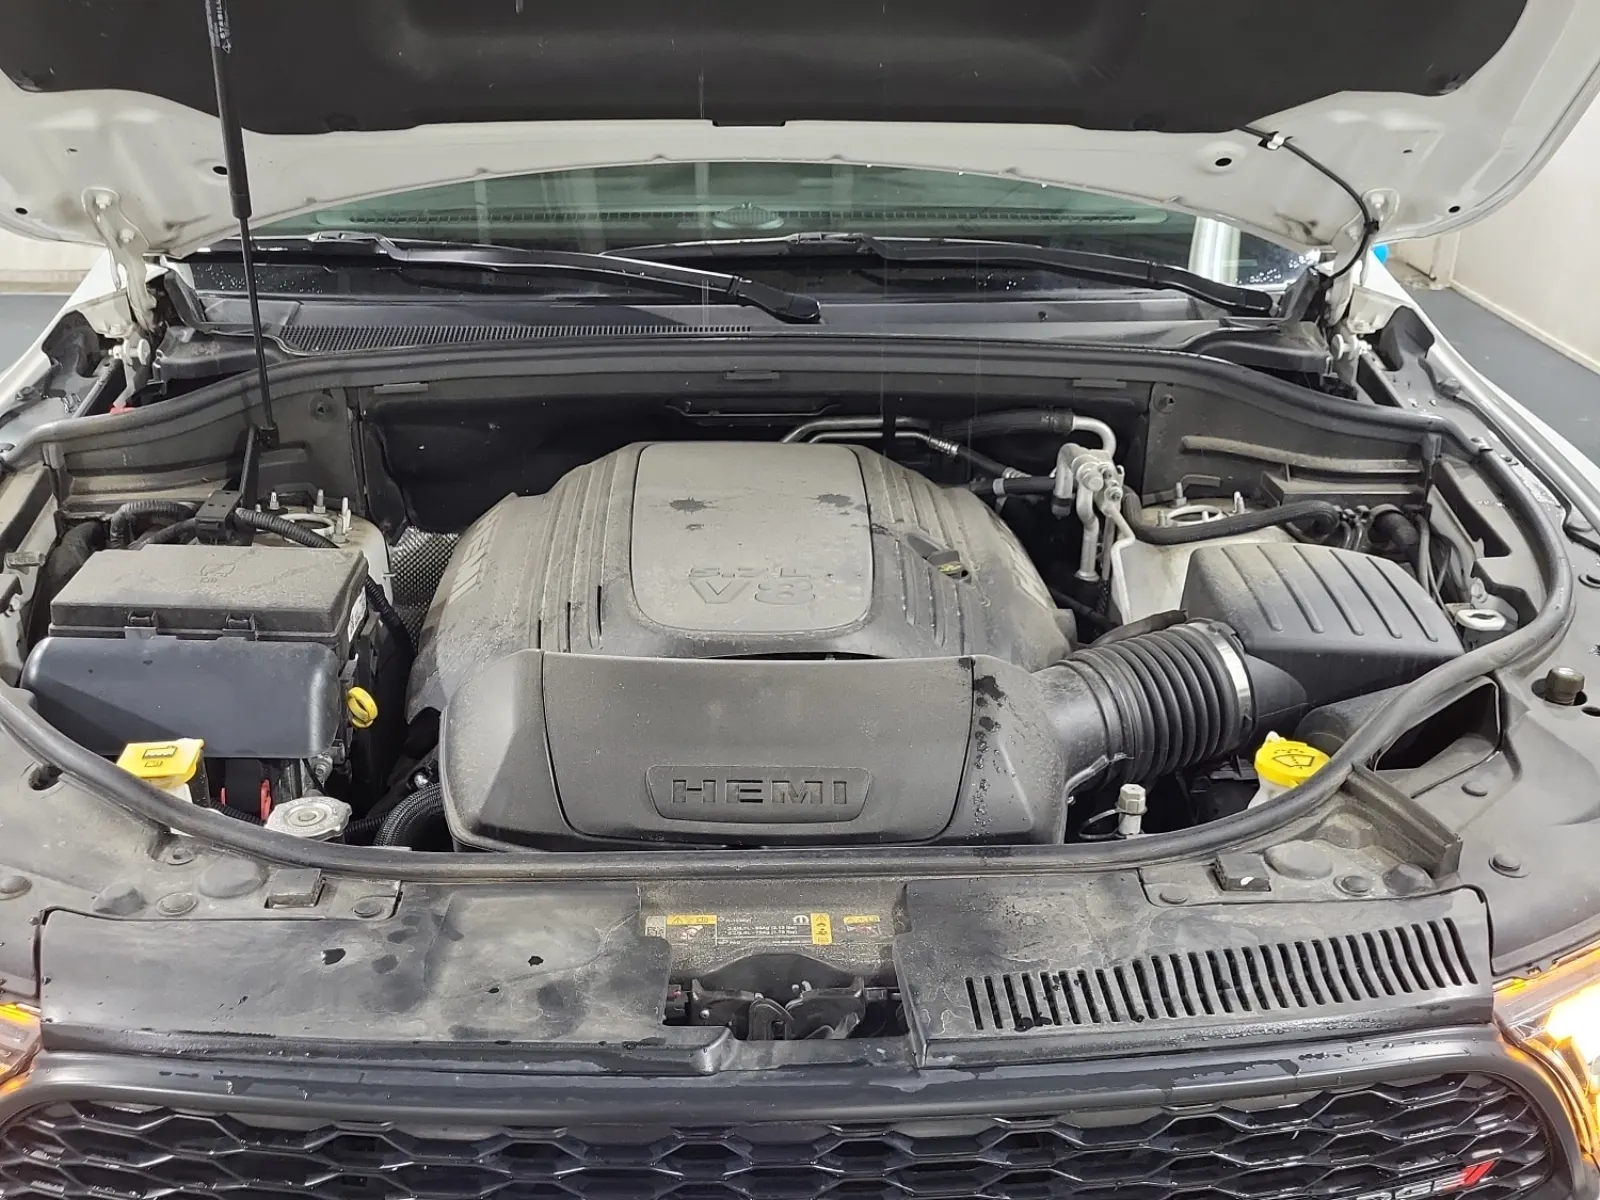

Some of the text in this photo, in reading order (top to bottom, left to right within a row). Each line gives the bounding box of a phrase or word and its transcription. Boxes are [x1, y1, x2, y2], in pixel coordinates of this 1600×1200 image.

[687, 566, 812, 578] 5.7L
[688, 578, 816, 606] V8
[672, 778, 848, 805] HEMI
